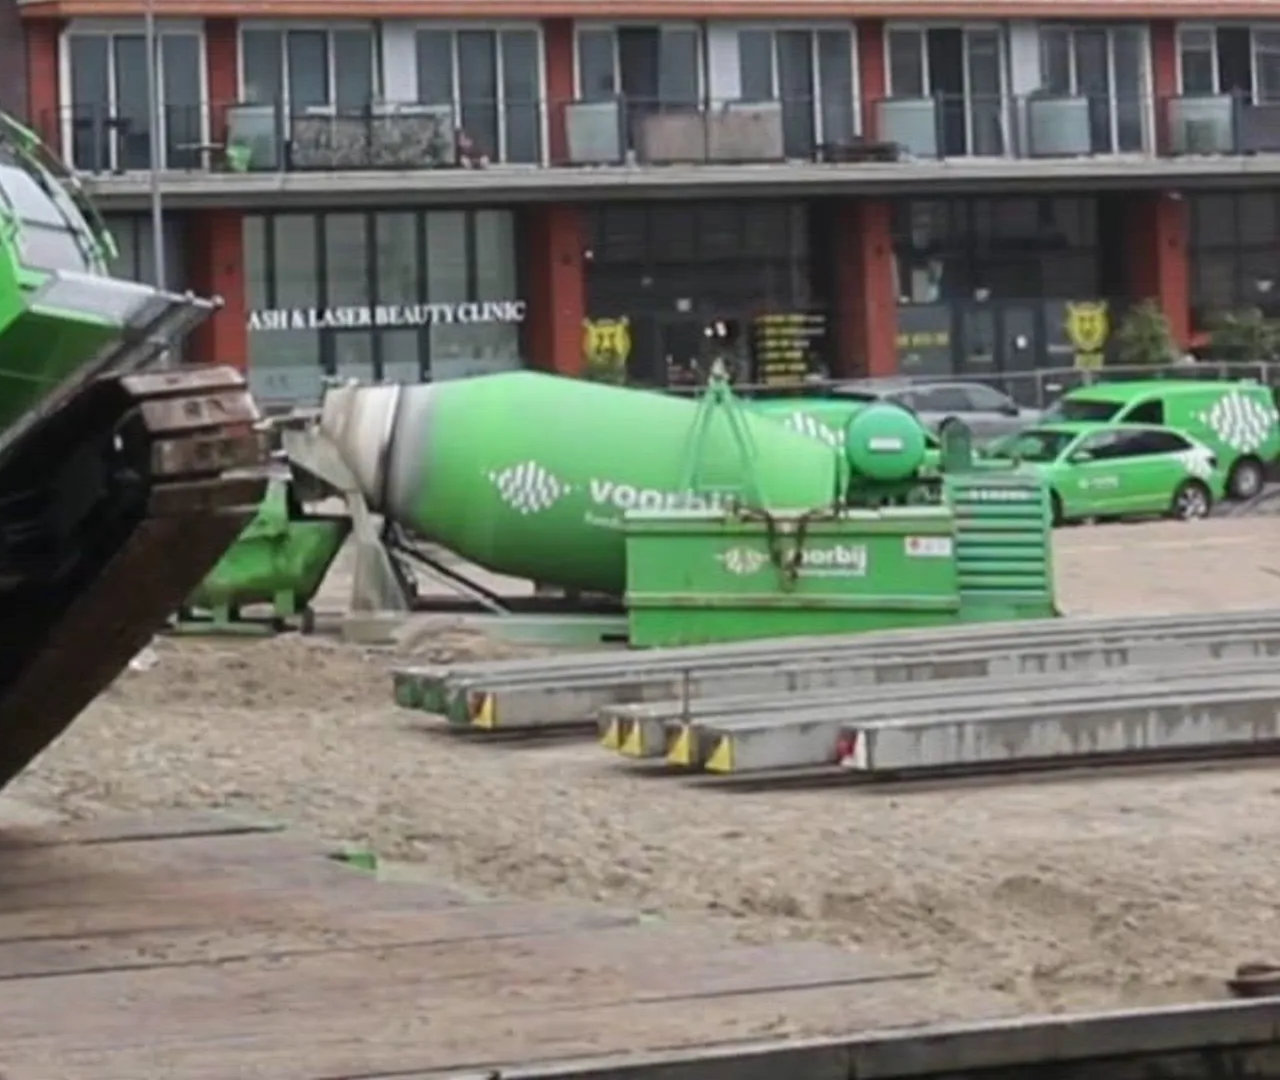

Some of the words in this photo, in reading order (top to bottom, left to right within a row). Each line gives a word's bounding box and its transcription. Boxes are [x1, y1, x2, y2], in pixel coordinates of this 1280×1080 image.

[248, 308, 286, 331] ASH
[308, 305, 372, 328] LASER
[374, 302, 454, 326] BEAUTY
[457, 299, 526, 322] CLINIC
